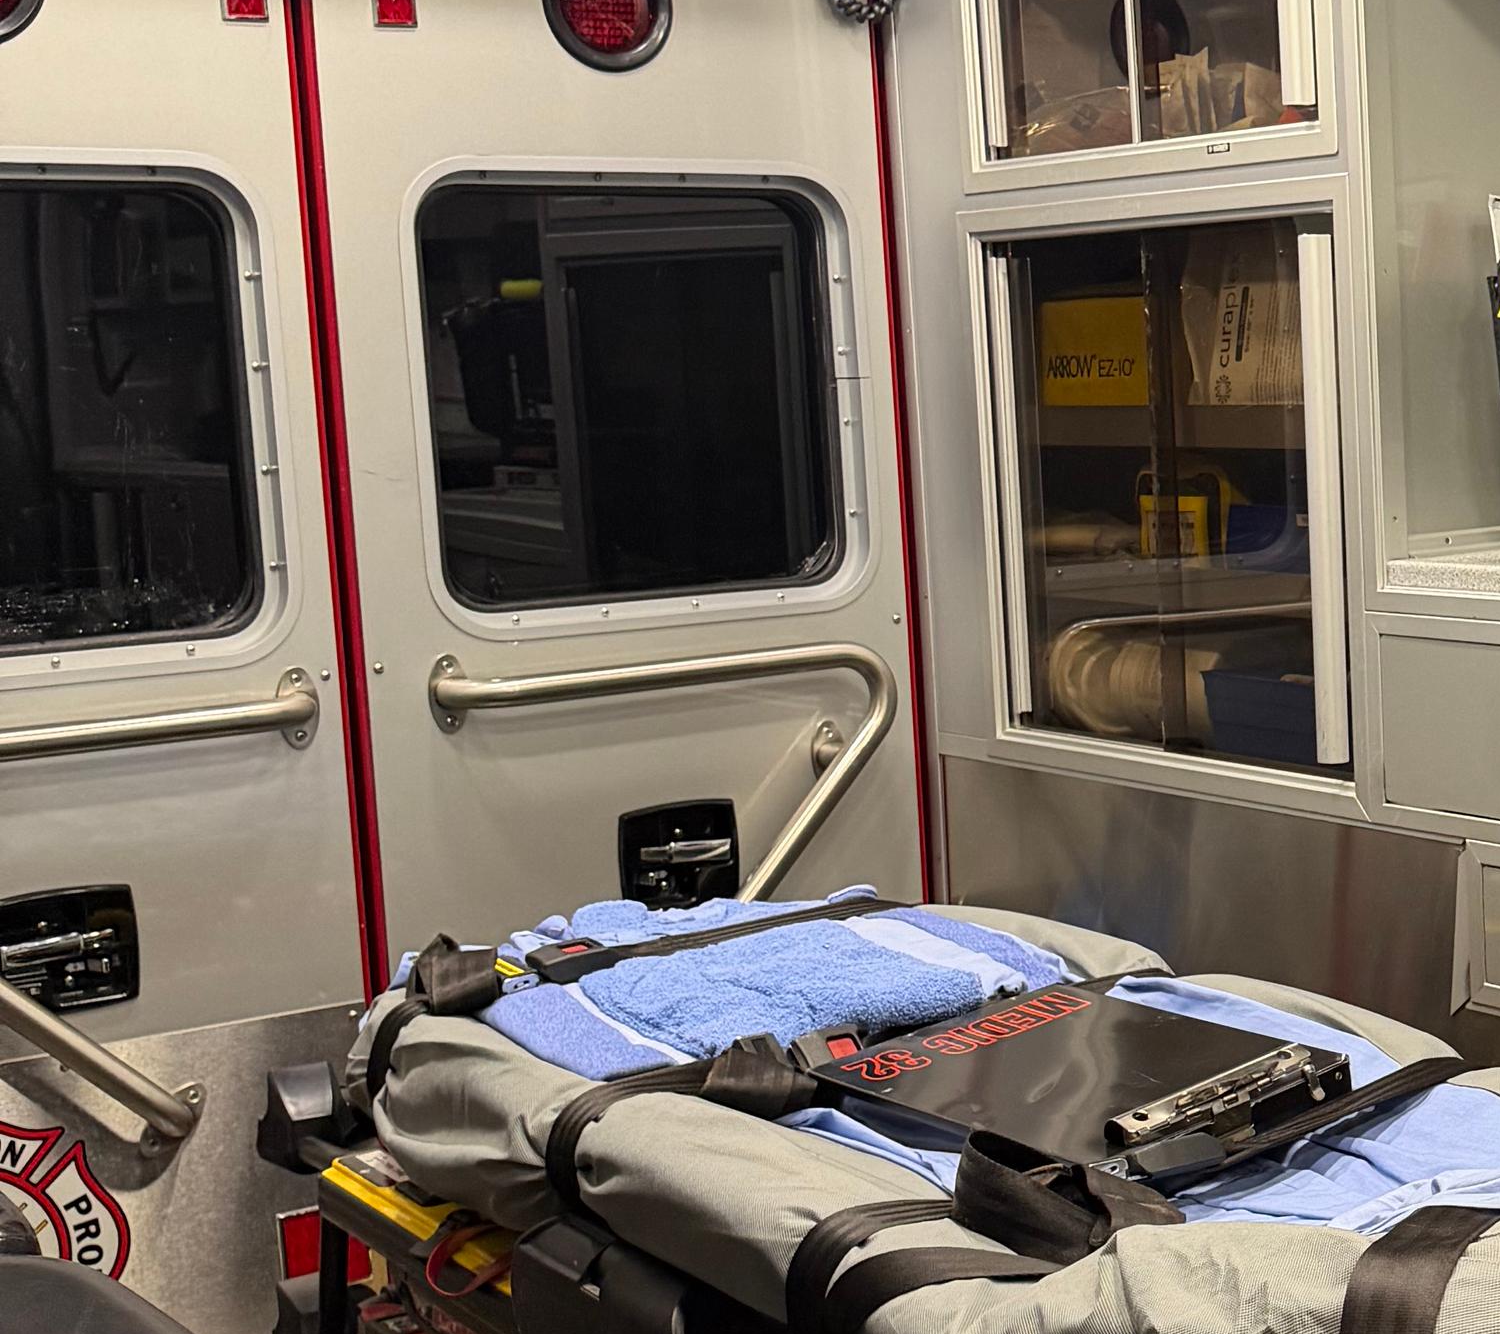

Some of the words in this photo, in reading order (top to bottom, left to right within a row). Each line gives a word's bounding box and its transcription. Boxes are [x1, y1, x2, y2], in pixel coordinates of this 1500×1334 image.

[921, 991, 1092, 1055] MEDIC
[840, 1049, 933, 1081] 32
[0, 1140, 26, 1168] N
[63, 1193, 104, 1273] PRO
